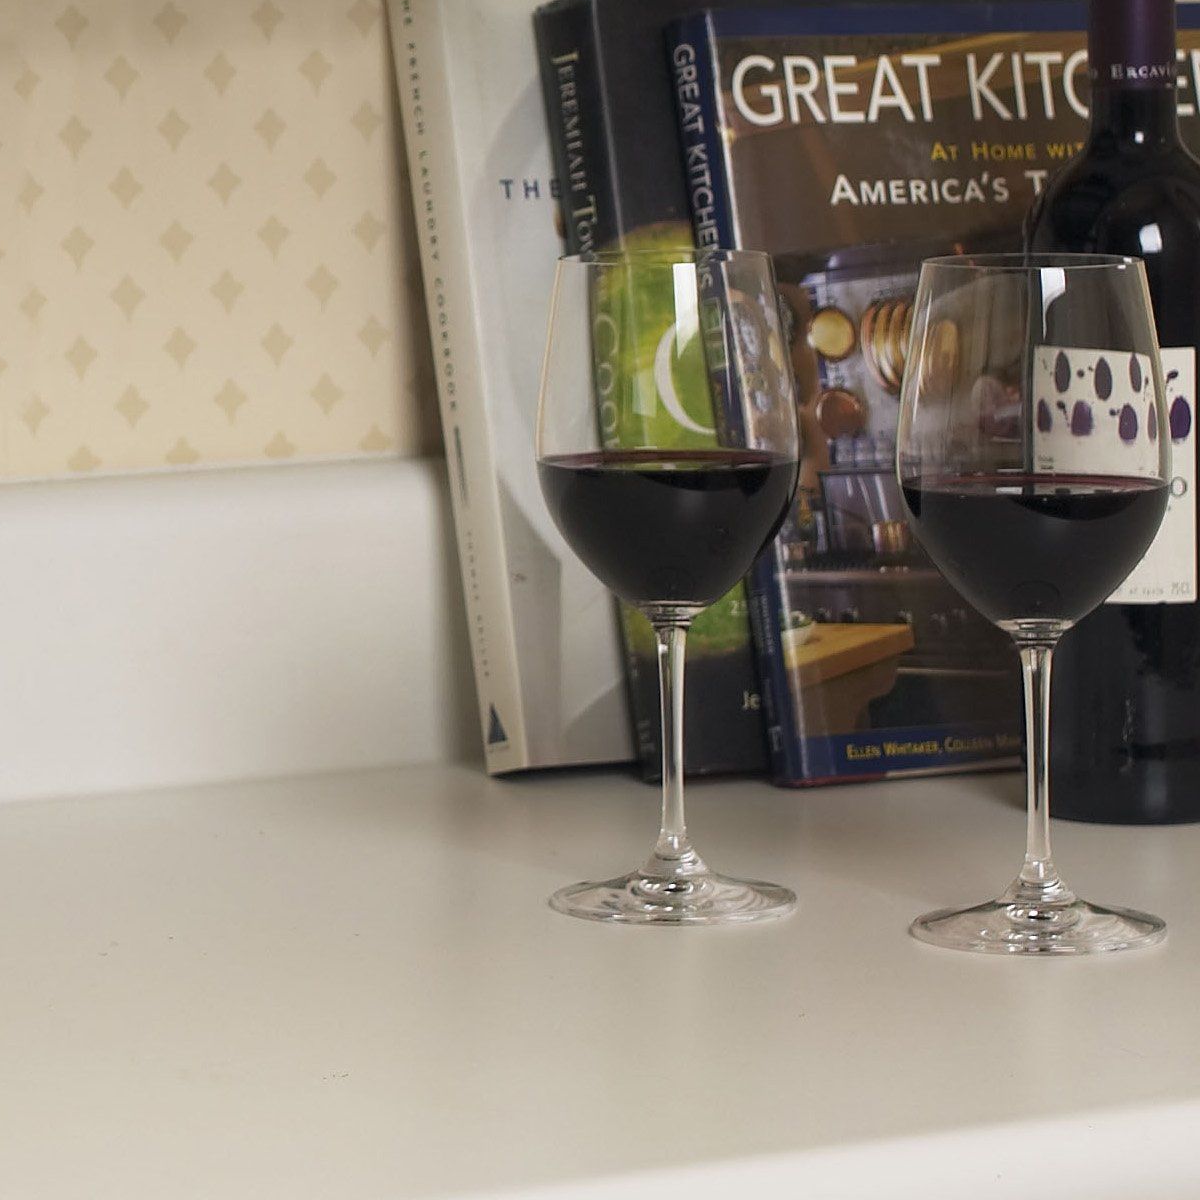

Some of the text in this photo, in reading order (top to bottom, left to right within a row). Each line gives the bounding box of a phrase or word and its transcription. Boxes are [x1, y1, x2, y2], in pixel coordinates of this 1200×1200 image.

[732, 54, 941, 126] GREAT
[673, 43, 722, 289] GREAT KITCHENS
[971, 140, 1036, 161] HOME
[830, 172, 1010, 206] AMERICA'S
